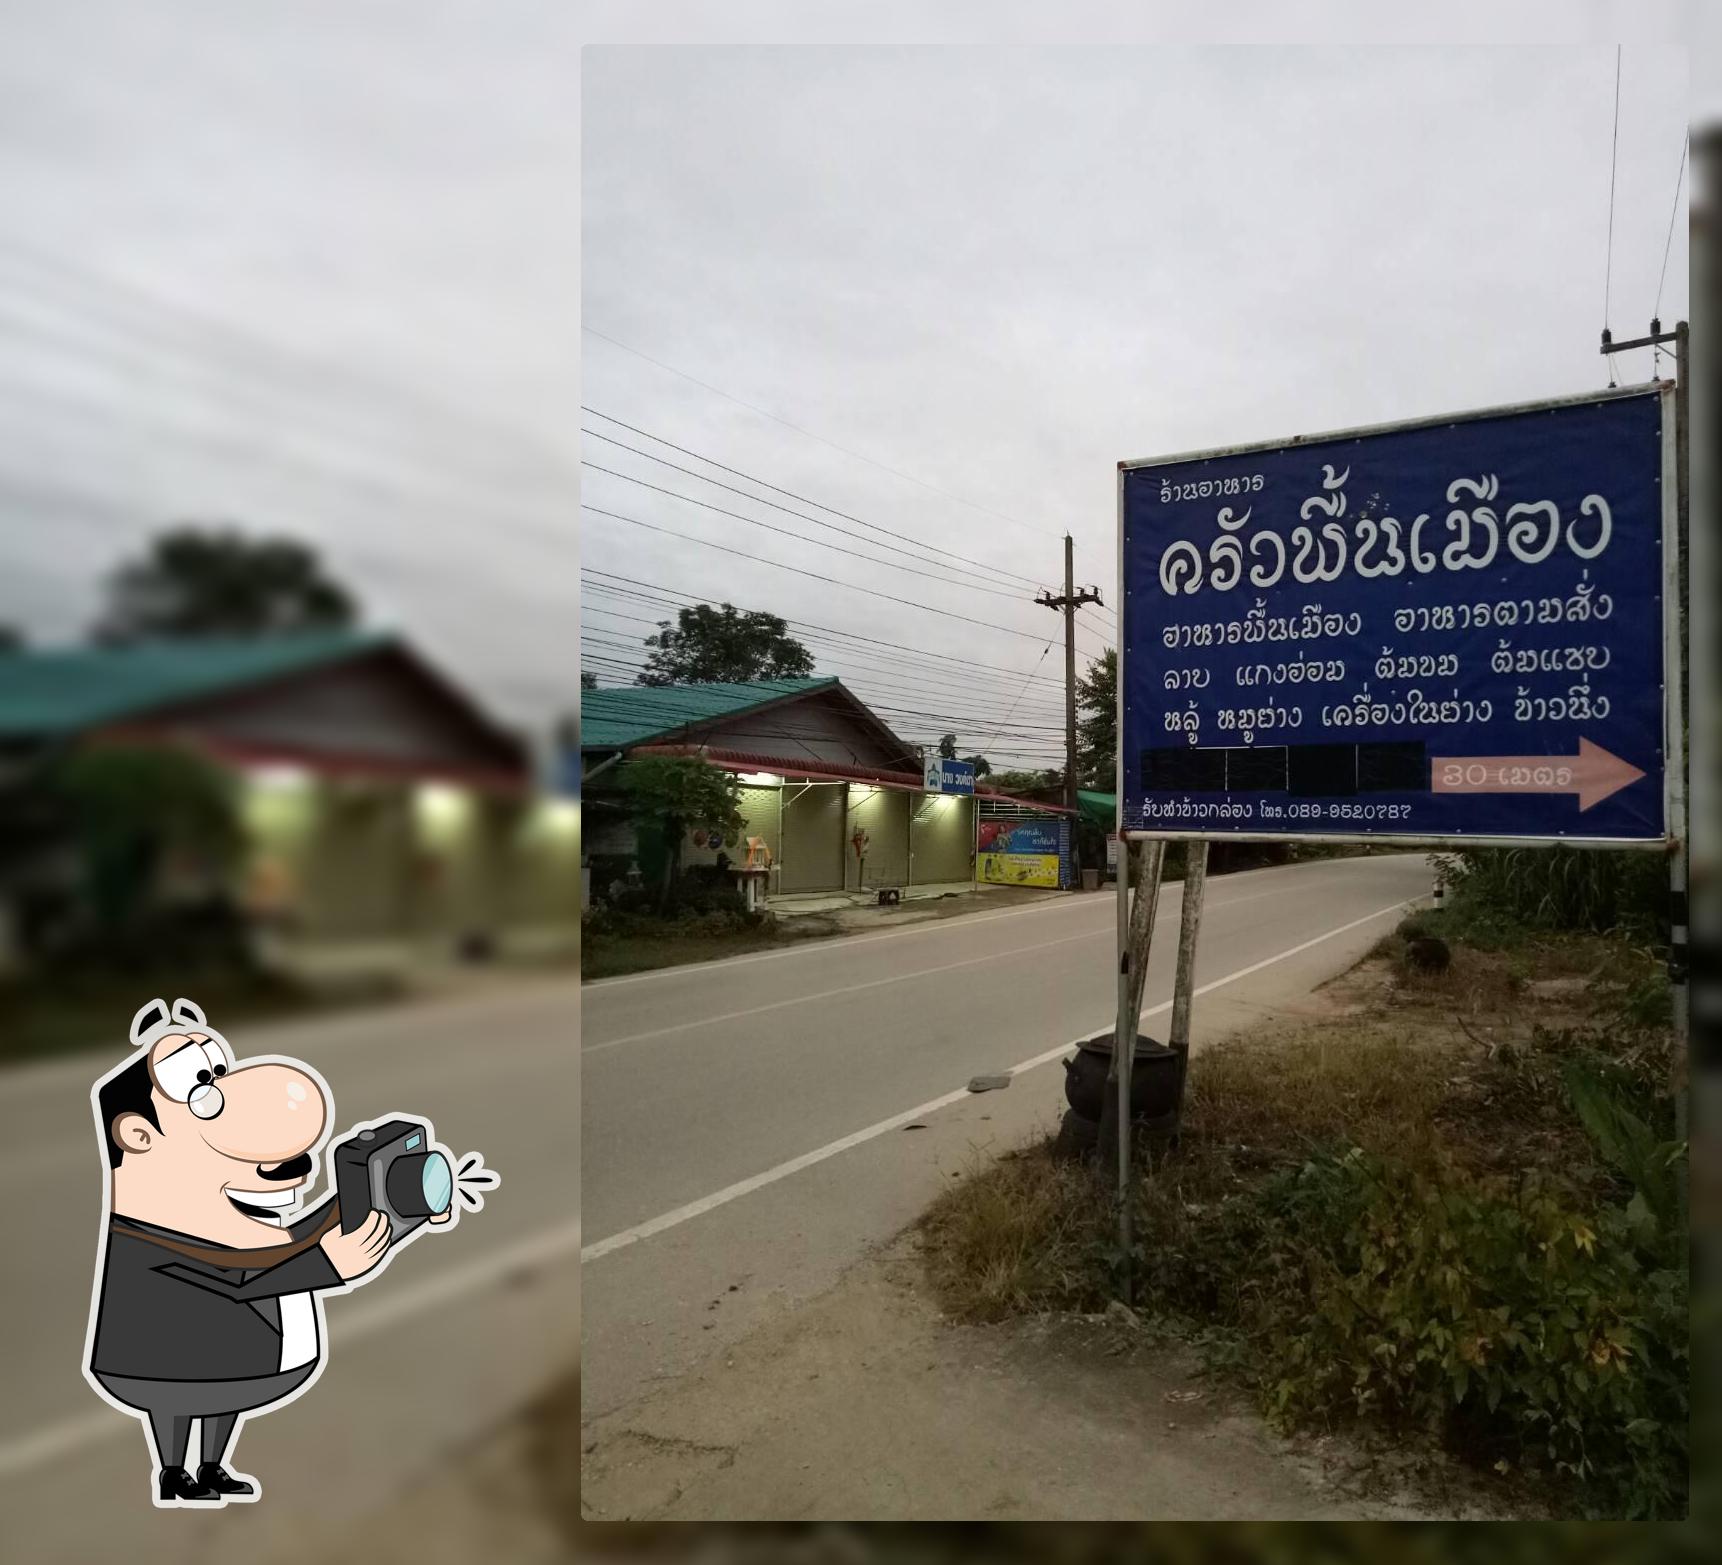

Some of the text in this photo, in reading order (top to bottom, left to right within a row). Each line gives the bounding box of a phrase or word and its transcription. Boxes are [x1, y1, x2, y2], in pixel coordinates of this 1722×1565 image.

[1160, 475, 1265, 503] ร้านอาหาร
[1159, 464, 1612, 596] ครัวพื้นเมือง
[1162, 568, 1613, 648] อาหารพื้นเมือง อาหารตามสั่ง
[1163, 668, 1211, 690] ลาบ
[1236, 650, 1345, 686] แกงอ่อม
[1374, 646, 1459, 679] ต้มขม
[1164, 672, 1610, 744] หลู้ หมูย่าง เครื่องในย่าง ข้าวนึ่ง
[1442, 764, 1572, 786] 30 เมตร
[1142, 797, 1253, 818] รับทำข้าวกล่อง
